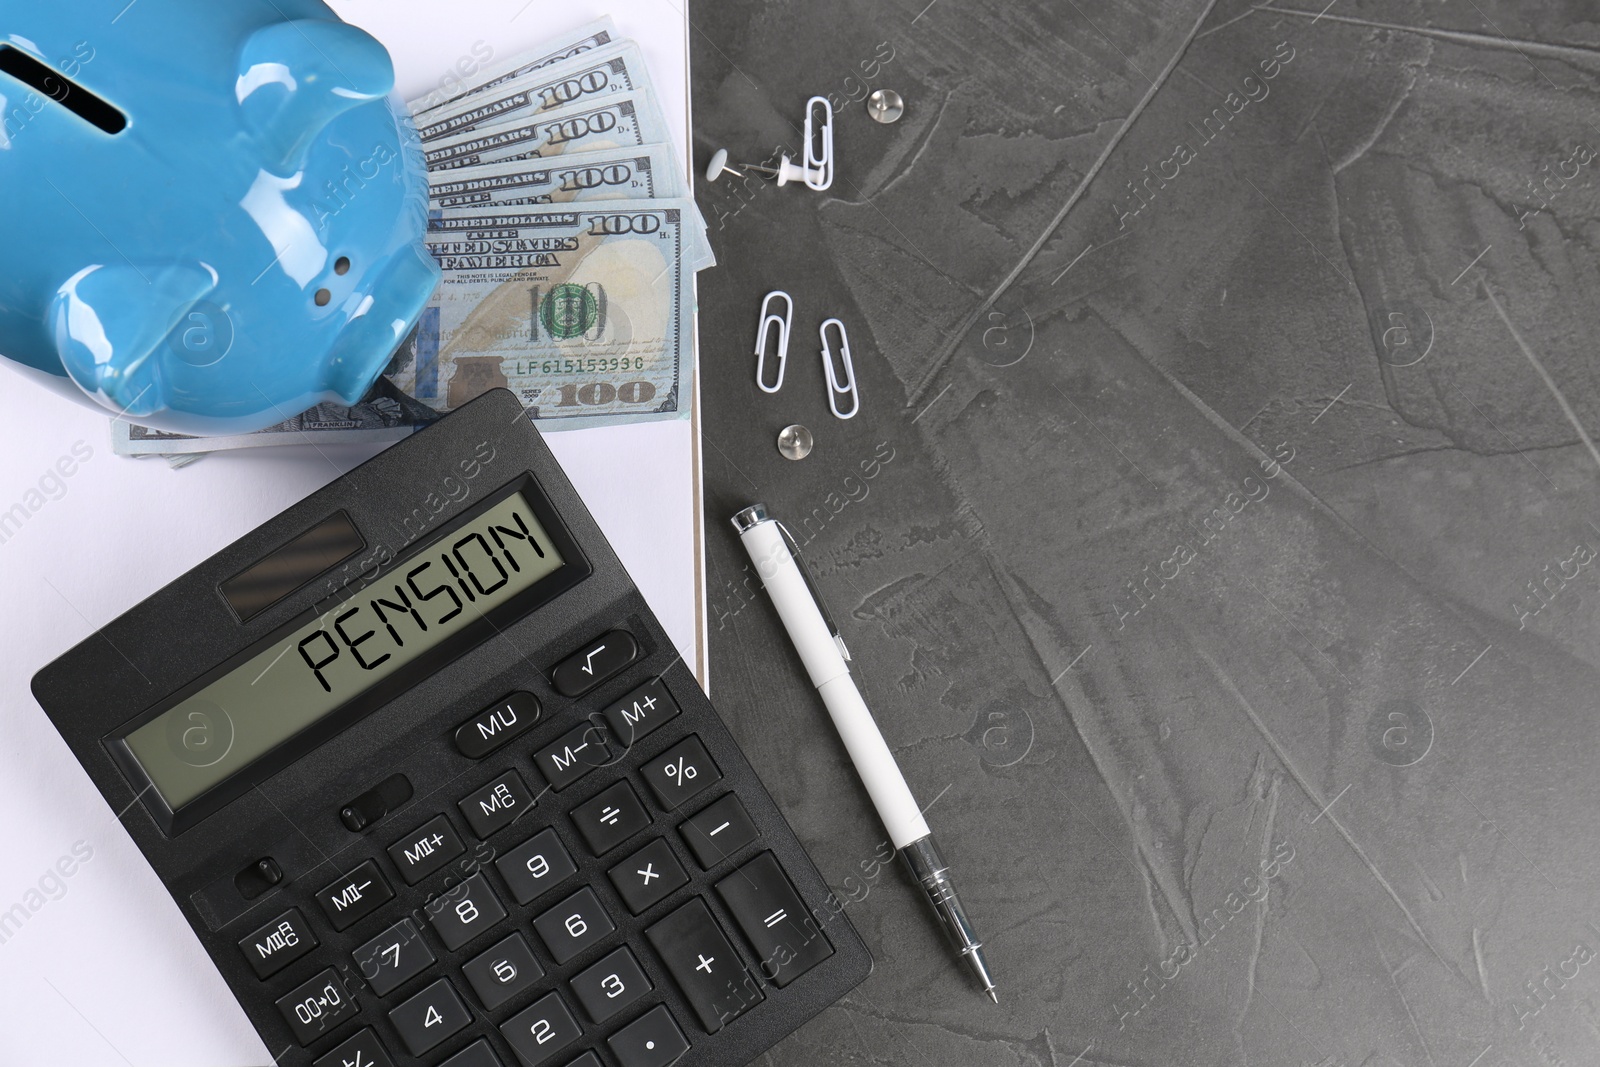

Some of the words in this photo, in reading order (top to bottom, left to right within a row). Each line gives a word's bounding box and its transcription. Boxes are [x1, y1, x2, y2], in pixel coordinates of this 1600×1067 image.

[538, 70, 608, 110] 100
[545, 111, 616, 146] 100
[559, 164, 631, 192] 100
[496, 213, 576, 227] DOLLARS
[588, 214, 661, 236] 100
[492, 237, 579, 253] STATES
[526, 282, 608, 342] 100
[555, 381, 656, 408] 100
[312, 420, 353, 429] FRANKLIN
[298, 512, 544, 692] PENSION
[477, 705, 517, 739] MU
[664, 756, 697, 786] %
[526, 855, 549, 879] 9
[455, 899, 479, 924] 8
[565, 914, 587, 937] 6
[381, 943, 400, 968] 7
[494, 960, 515, 982] 5
[601, 974, 625, 998] 3
[424, 1005, 443, 1028] 4
[531, 1019, 556, 1044] 2
